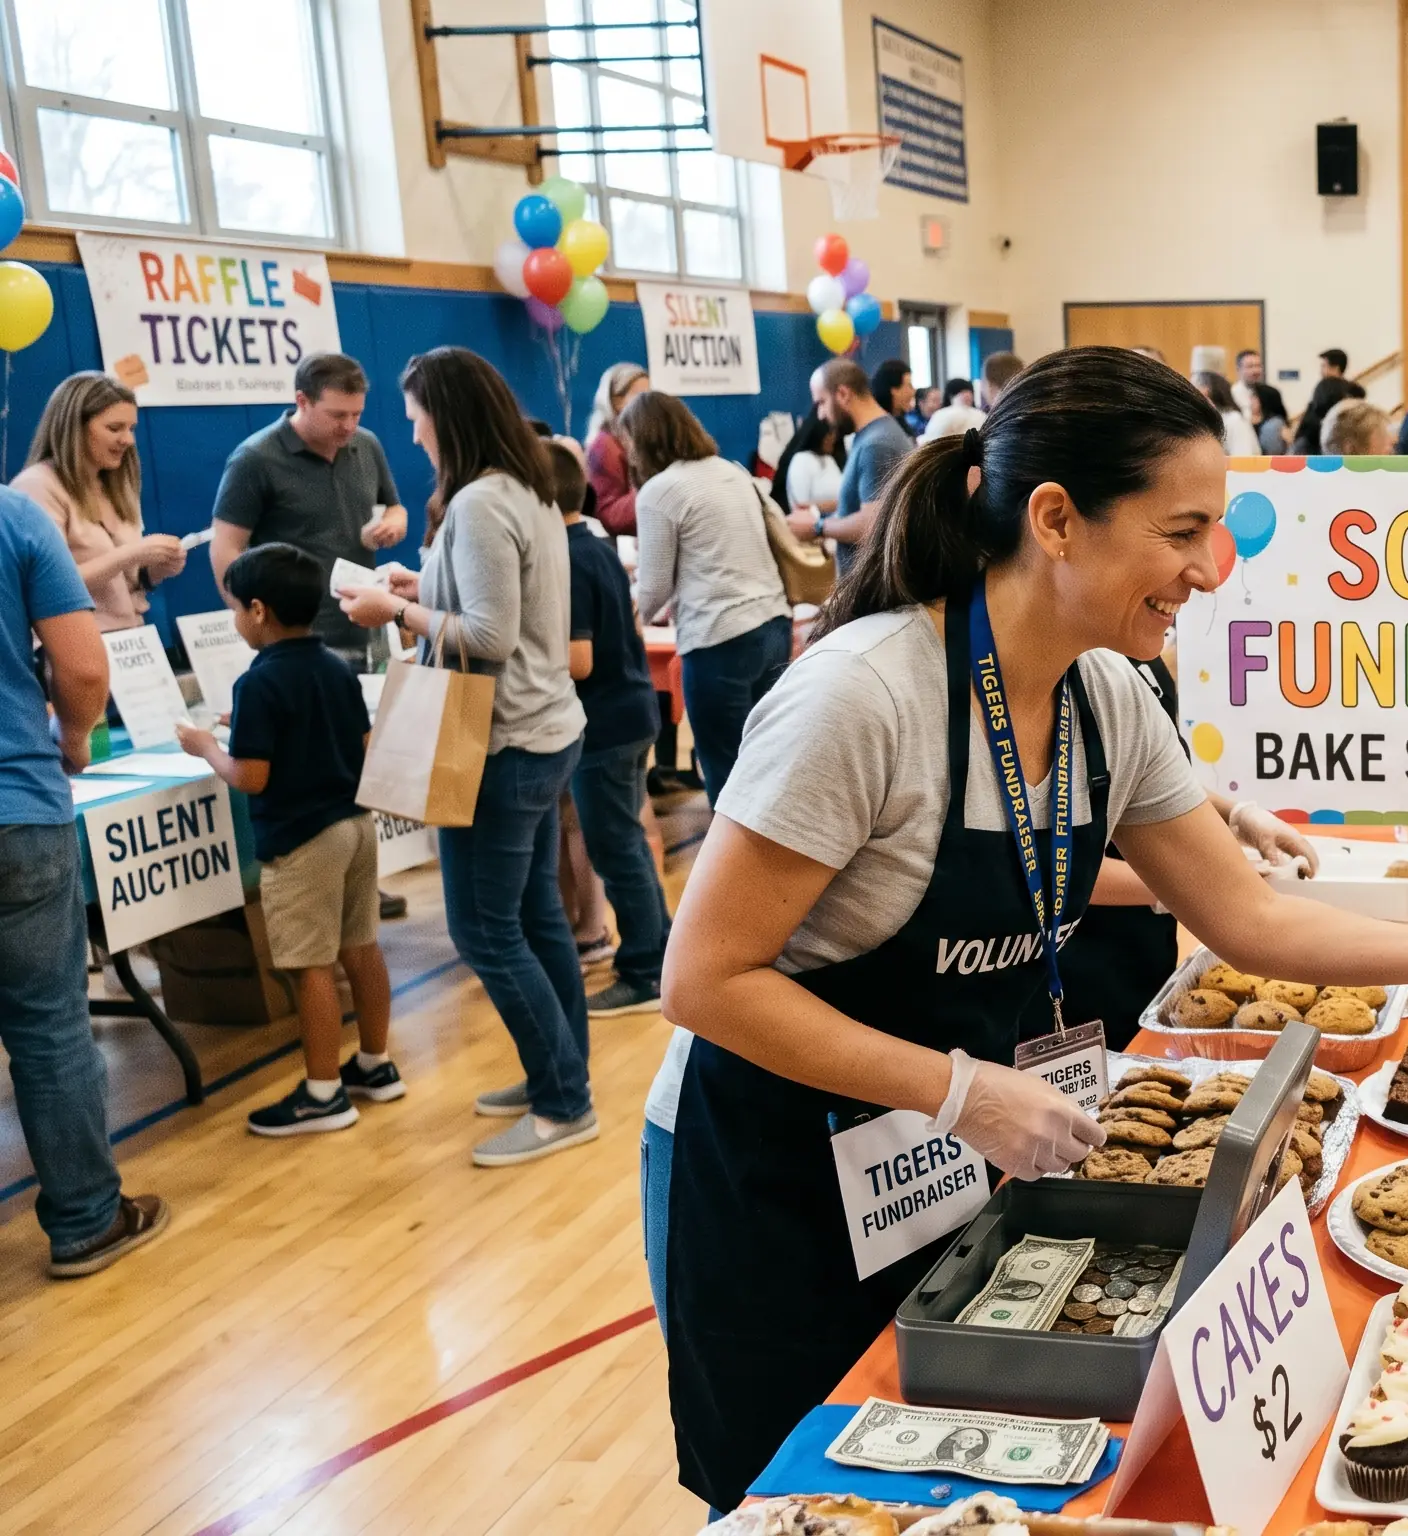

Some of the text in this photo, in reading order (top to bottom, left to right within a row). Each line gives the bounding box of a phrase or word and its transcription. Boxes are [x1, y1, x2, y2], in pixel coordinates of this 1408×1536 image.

[139, 251, 285, 308] RAFFLE
[664, 293, 728, 328] SILENT
[140, 314, 302, 366] TICKETS
[664, 334, 742, 367] AUCTION
[978, 653, 1007, 731] TIGERS
[1255, 732, 1386, 782] BAKE
[105, 794, 217, 863] SILENT
[111, 840, 231, 911] AUCTION
[1041, 1060, 1091, 1085] TIGERS
[865, 1132, 962, 1197] TIGERS
[862, 1163, 977, 1238] FUNDRAISER
[1192, 1222, 1310, 1422] CAKES
[1253, 1364, 1302, 1462] $2
